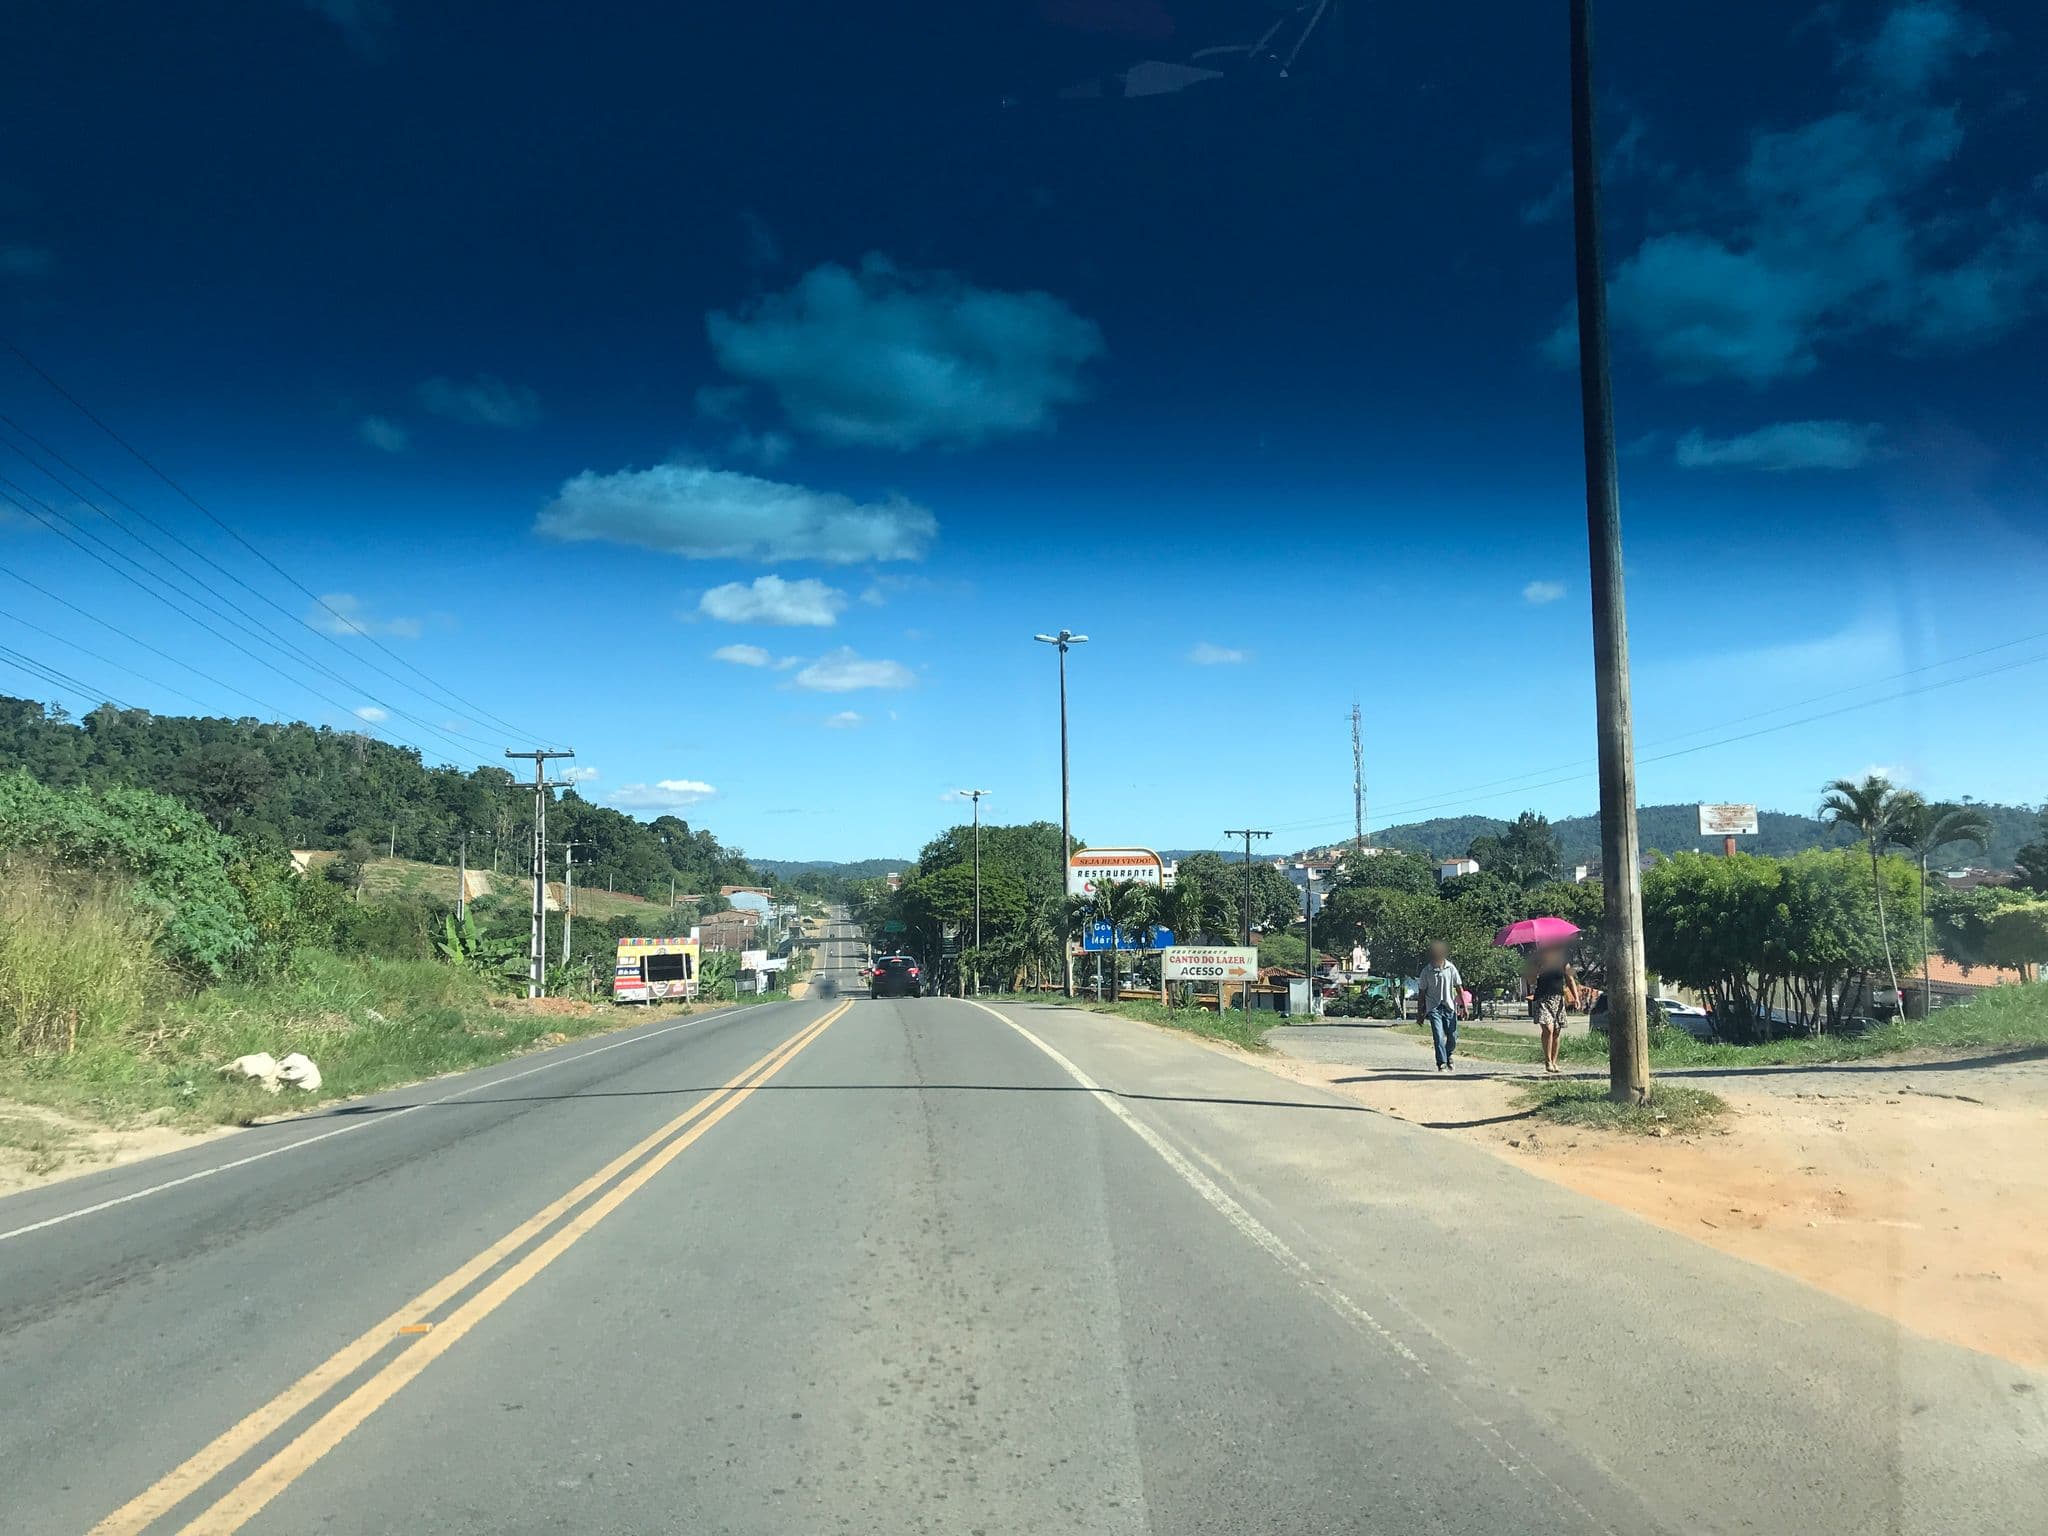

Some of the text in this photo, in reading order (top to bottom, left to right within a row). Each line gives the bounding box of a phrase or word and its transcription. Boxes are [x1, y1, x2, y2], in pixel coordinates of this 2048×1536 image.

[1077, 869, 1154, 878] RESTAURANTE
[1169, 956, 1245, 964] CANTO DO LAZER
[1180, 967, 1224, 976] ACESSO
